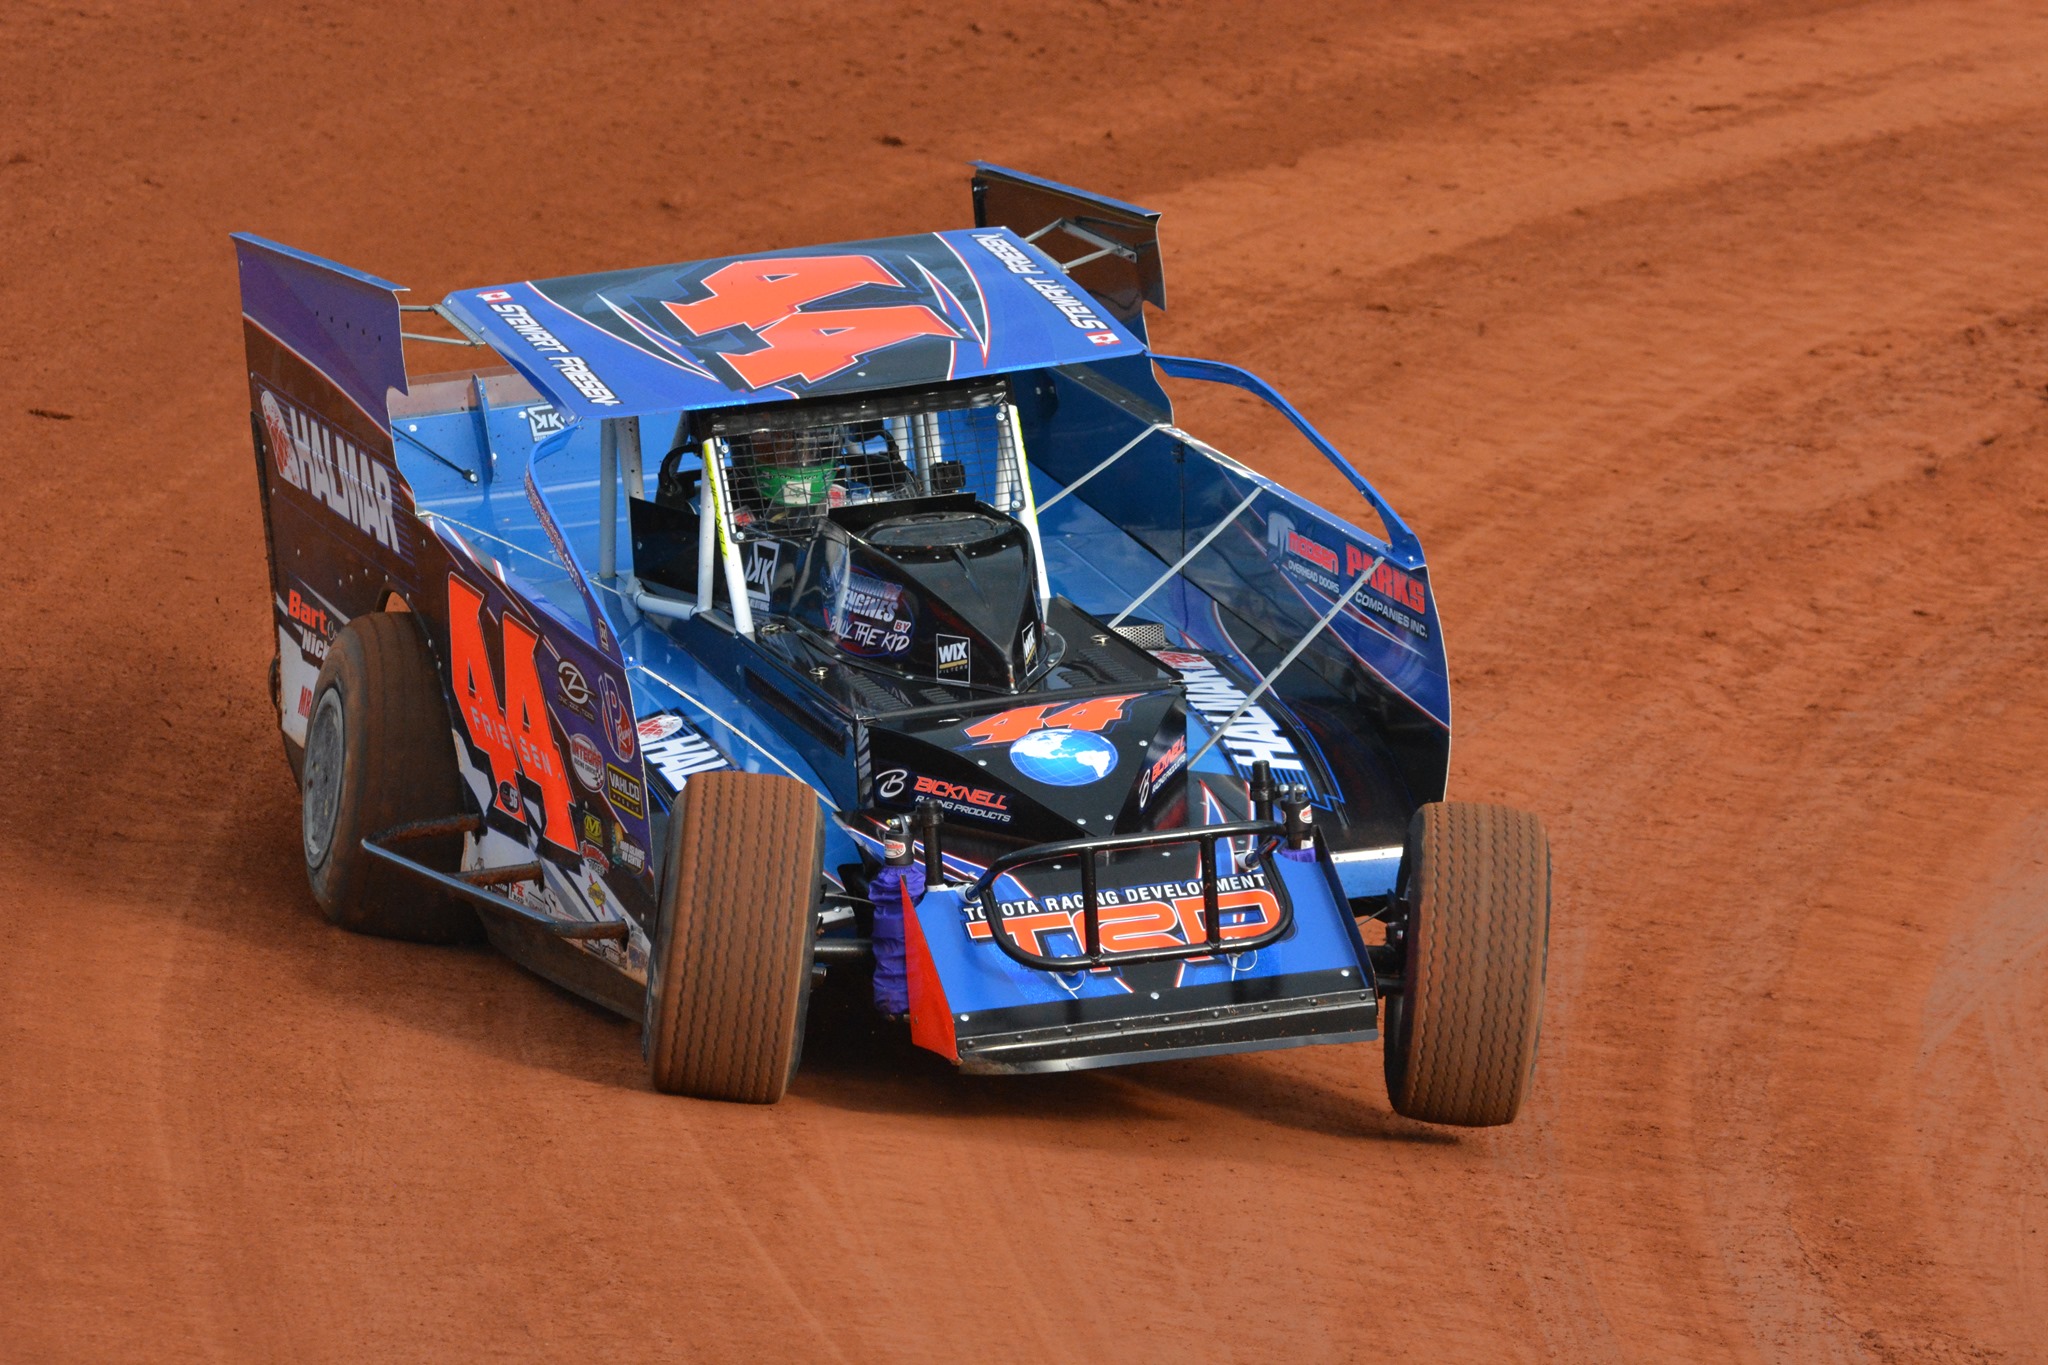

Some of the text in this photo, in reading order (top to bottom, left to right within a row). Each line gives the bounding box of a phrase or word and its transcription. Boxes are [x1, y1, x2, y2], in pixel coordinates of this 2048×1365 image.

[971, 233, 1109, 330] STEWART FRIESEN
[660, 255, 965, 389] 44
[490, 303, 621, 405] STEWART FRIESEN
[289, 406, 401, 554] HALMAR
[1288, 559, 1340, 594] OVERHEAD DOORS
[1345, 543, 1426, 615] PARKS
[288, 588, 328, 635] Bart
[841, 588, 899, 622] ENGINES
[894, 620, 911, 633] BY
[1355, 591, 1429, 638] COMPANIES INC.
[853, 621, 885, 647] THE
[880, 632, 910, 652] KID
[938, 641, 968, 664] WIX
[448, 571, 581, 855] 44
[963, 691, 1150, 746] 44
[608, 770, 640, 802] VAHLCO
[641, 733, 729, 792] HAL
[913, 775, 1008, 811] BICKNELL
[953, 803, 1012, 823] PRODUCTS
[963, 873, 1265, 921] TOOTA RACNG DEVELOMENT
[965, 888, 1282, 973] TRD
